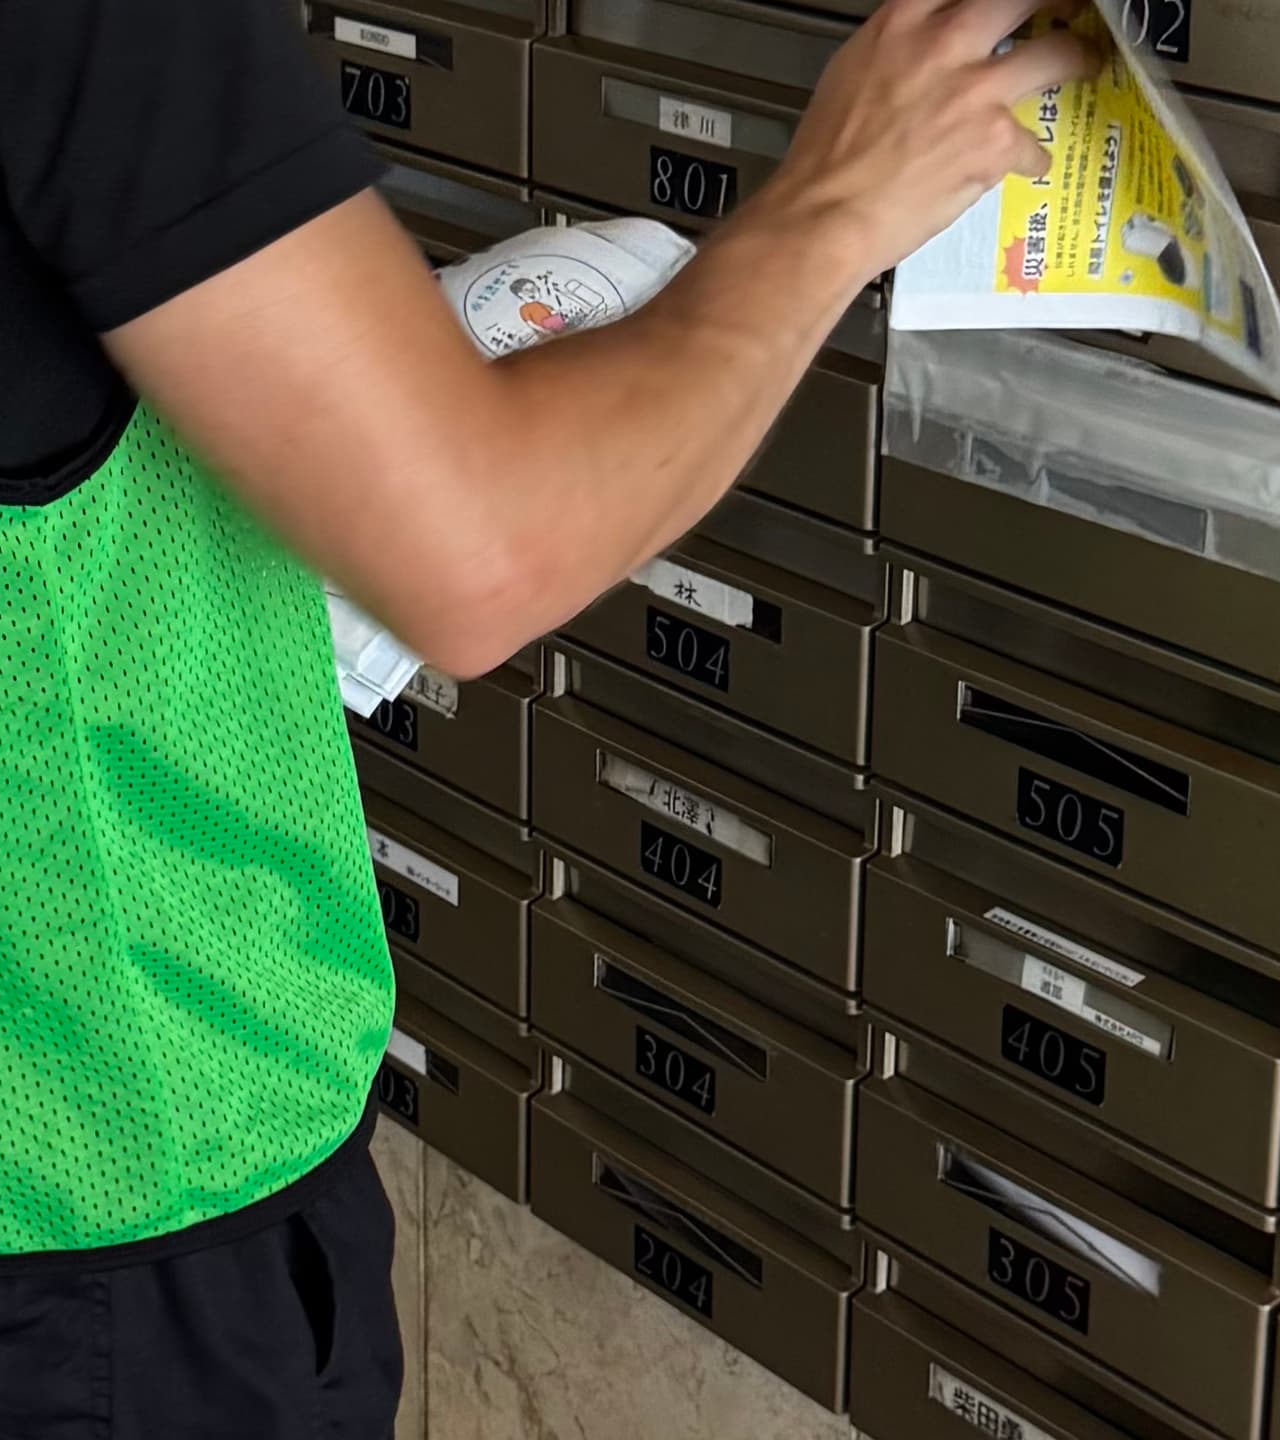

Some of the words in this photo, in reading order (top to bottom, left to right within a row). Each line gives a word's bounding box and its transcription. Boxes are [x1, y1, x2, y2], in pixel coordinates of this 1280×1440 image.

[344, 64, 407, 122] 703
[653, 155, 728, 217] 801
[674, 578, 701, 609] 林
[649, 615, 726, 686] 504
[377, 703, 415, 743] 03
[1023, 777, 1120, 857] 505
[644, 836, 718, 900] 404
[639, 1033, 712, 1107] 304
[1006, 1020, 1101, 1093] 405
[636, 1232, 707, 1309] 204
[991, 1236, 1084, 1322] 305
